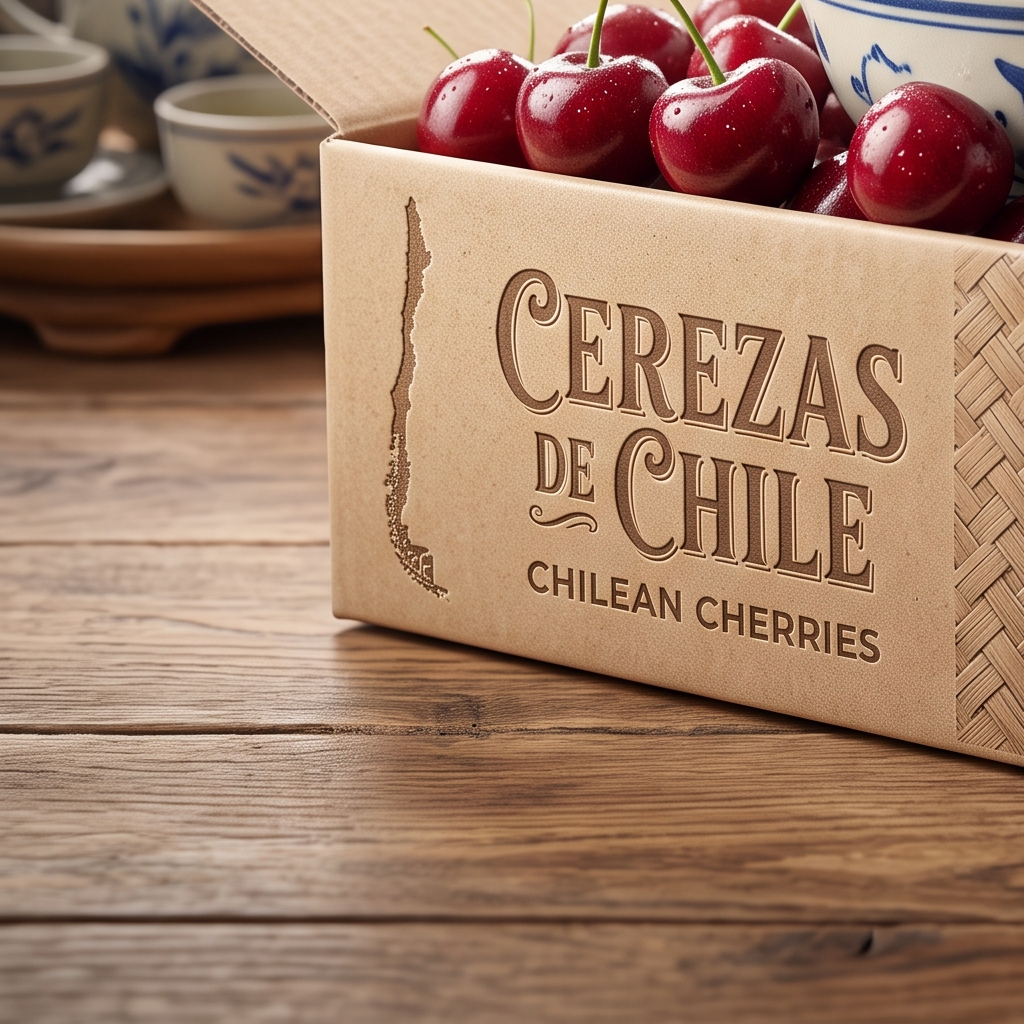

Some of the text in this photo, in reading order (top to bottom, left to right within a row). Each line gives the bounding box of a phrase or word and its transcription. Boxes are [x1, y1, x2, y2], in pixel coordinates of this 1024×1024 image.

[496, 268, 908, 463] CEREZAS
[534, 427, 874, 593] DE CHILE
[527, 560, 881, 663] CHILEAN CHERRIES
